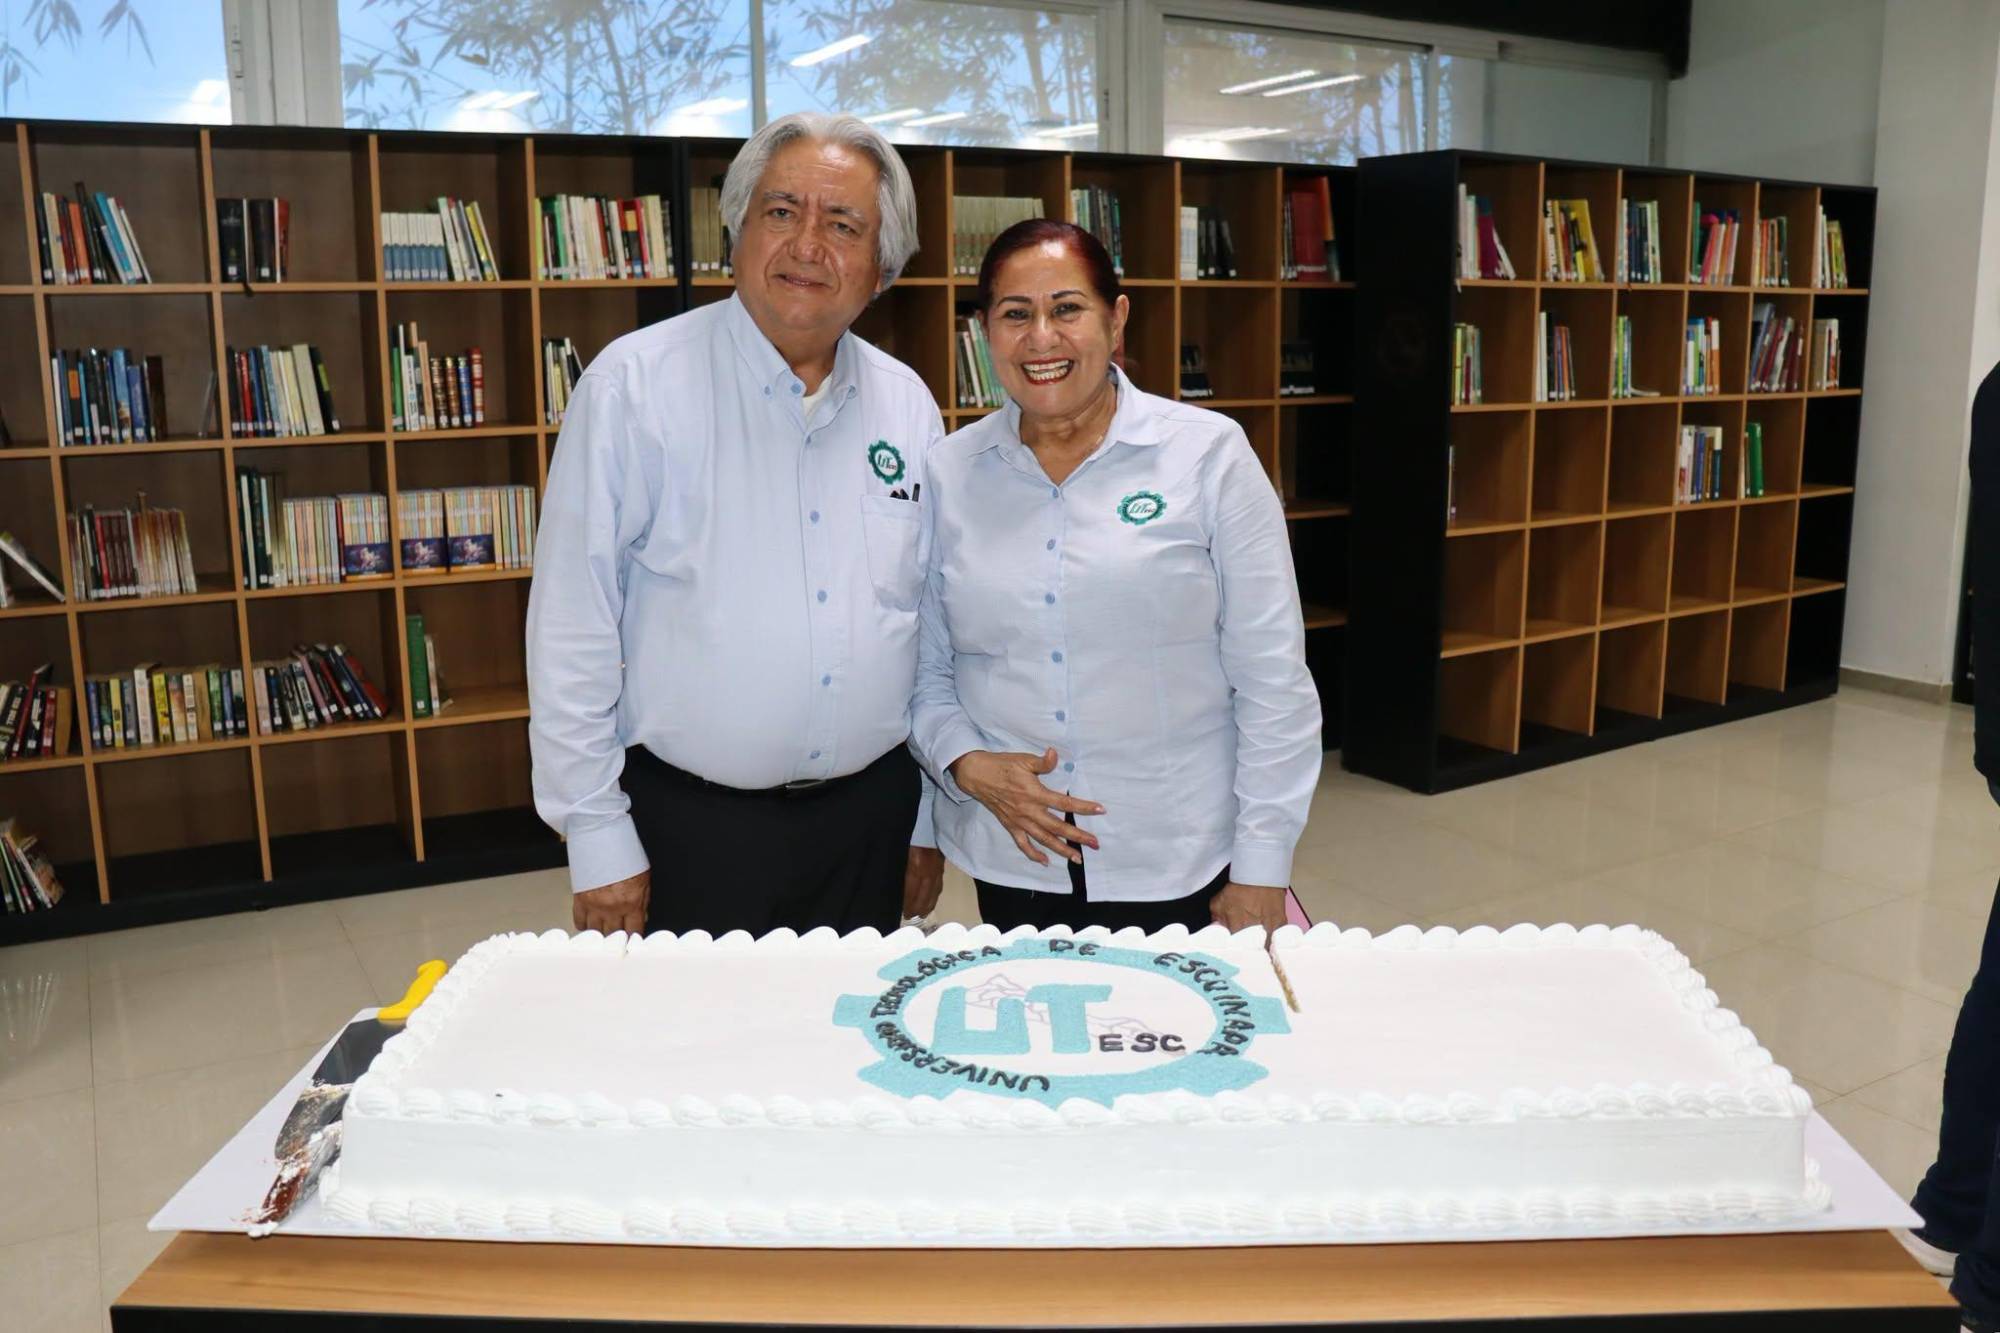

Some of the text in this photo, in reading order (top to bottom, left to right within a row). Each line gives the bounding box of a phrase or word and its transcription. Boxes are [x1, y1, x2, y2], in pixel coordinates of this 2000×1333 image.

[1049, 938, 1101, 956] DE
[1153, 951, 1256, 1056] ESCUINAPA
[1099, 1032, 1187, 1053] ESC
